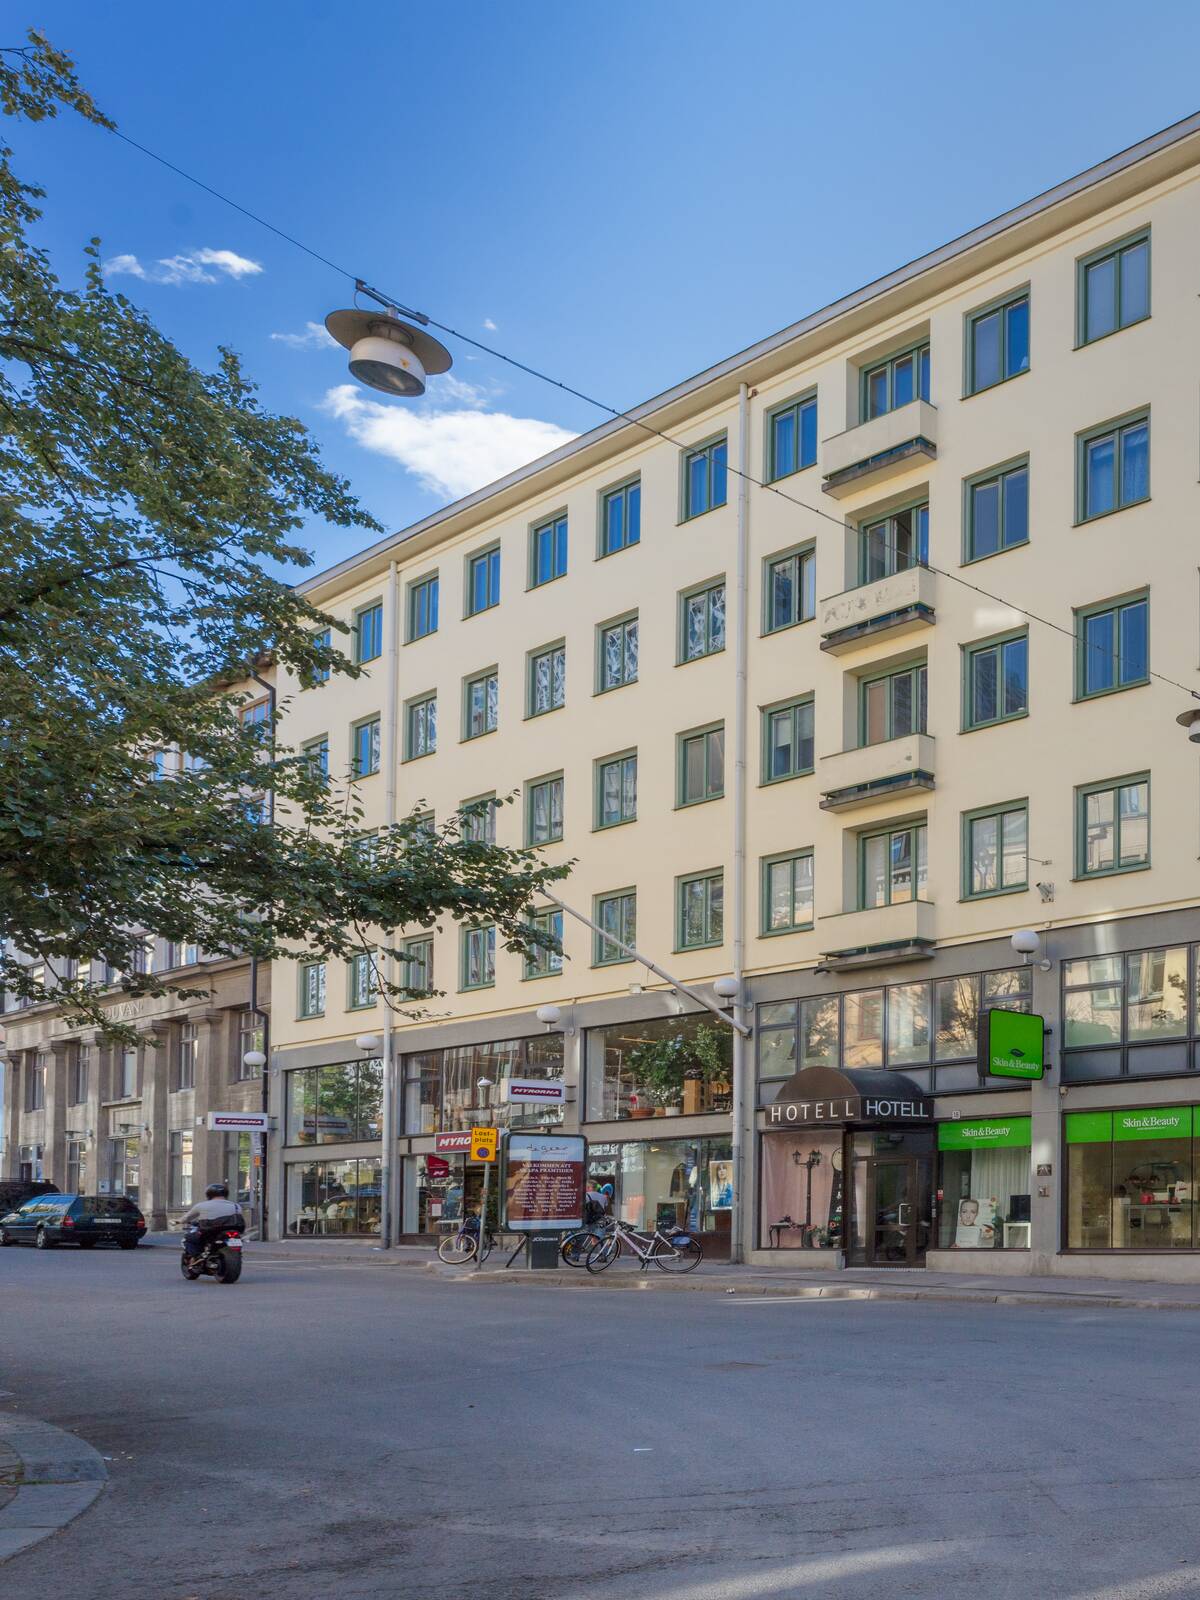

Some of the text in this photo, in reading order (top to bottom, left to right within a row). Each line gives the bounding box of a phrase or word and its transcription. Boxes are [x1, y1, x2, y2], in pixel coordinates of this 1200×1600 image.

[771, 1101, 854, 1122] HOTELL
[866, 1100, 929, 1118] HOTELL
[439, 1137, 471, 1147] MYRO
